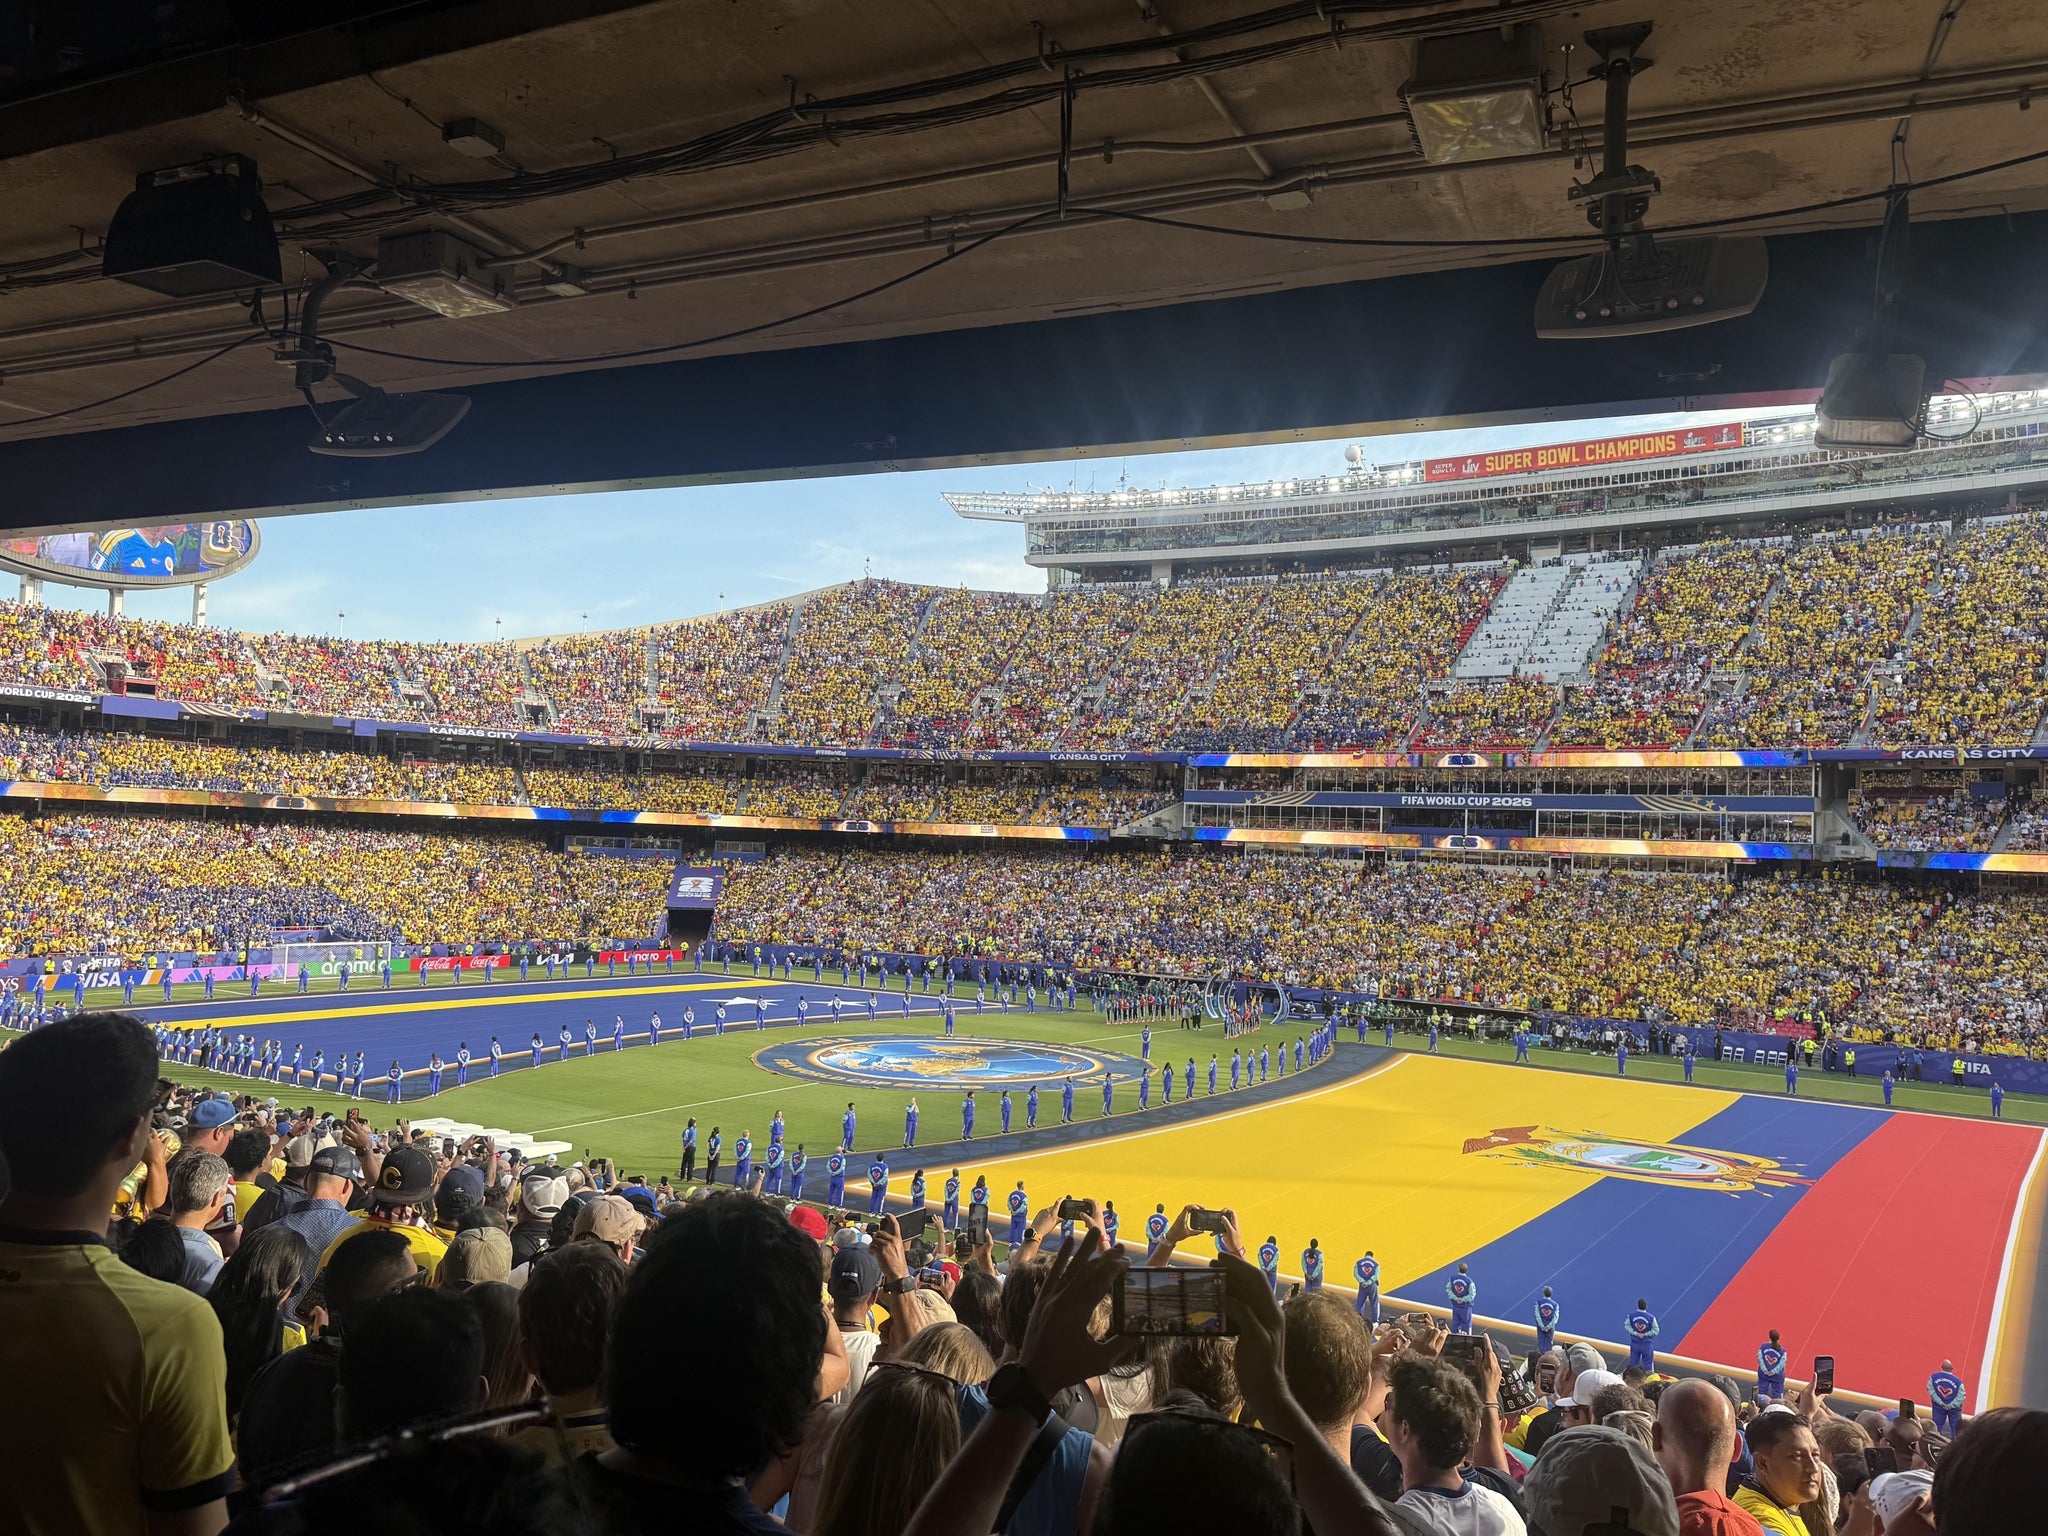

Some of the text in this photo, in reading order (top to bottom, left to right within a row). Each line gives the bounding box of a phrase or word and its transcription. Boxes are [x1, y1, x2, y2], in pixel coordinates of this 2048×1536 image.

[1486, 452, 1532, 472] SUPER
[1538, 446, 1580, 467] BOWL
[1585, 434, 1676, 461] CHAMPIONS
[34, 690, 55, 699] CUP
[56, 692, 92, 703] 2026
[430, 727, 518, 739] KANSAS CITY
[1987, 749, 2035, 758] CITY
[1401, 796, 1533, 807] FIFA WORLD CUP 2026
[383, 1166, 402, 1190] C
